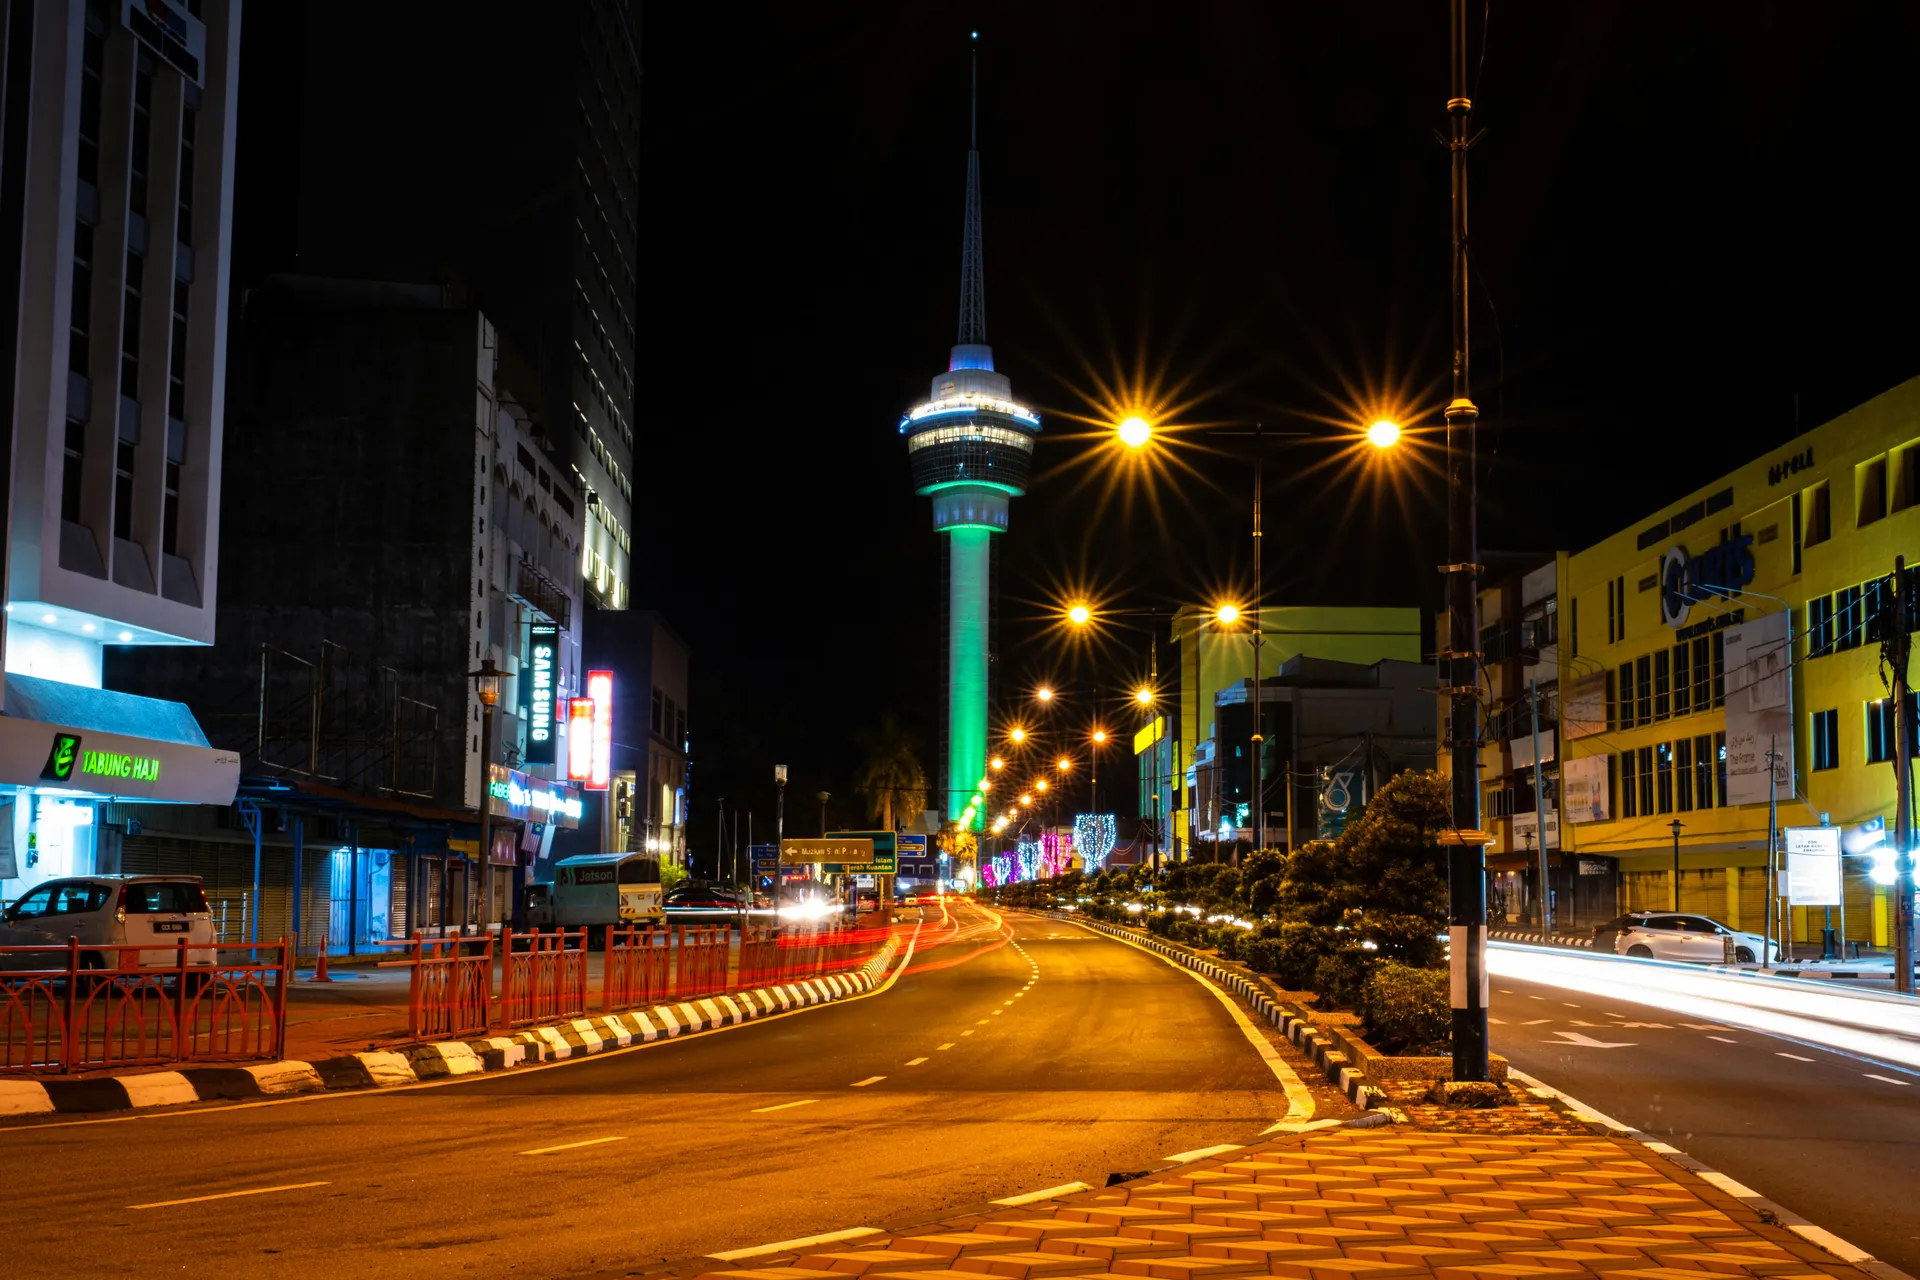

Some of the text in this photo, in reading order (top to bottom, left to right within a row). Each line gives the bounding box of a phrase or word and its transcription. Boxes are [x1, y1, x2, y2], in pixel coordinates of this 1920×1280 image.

[532, 646, 552, 741] SAMSUNG
[1730, 754, 1739, 765] The
[81, 750, 160, 781] TABUNG HAJI
[801, 847, 825, 855] Muzium
[826, 847, 841, 855] Sni
[579, 870, 613, 881] Jatson
